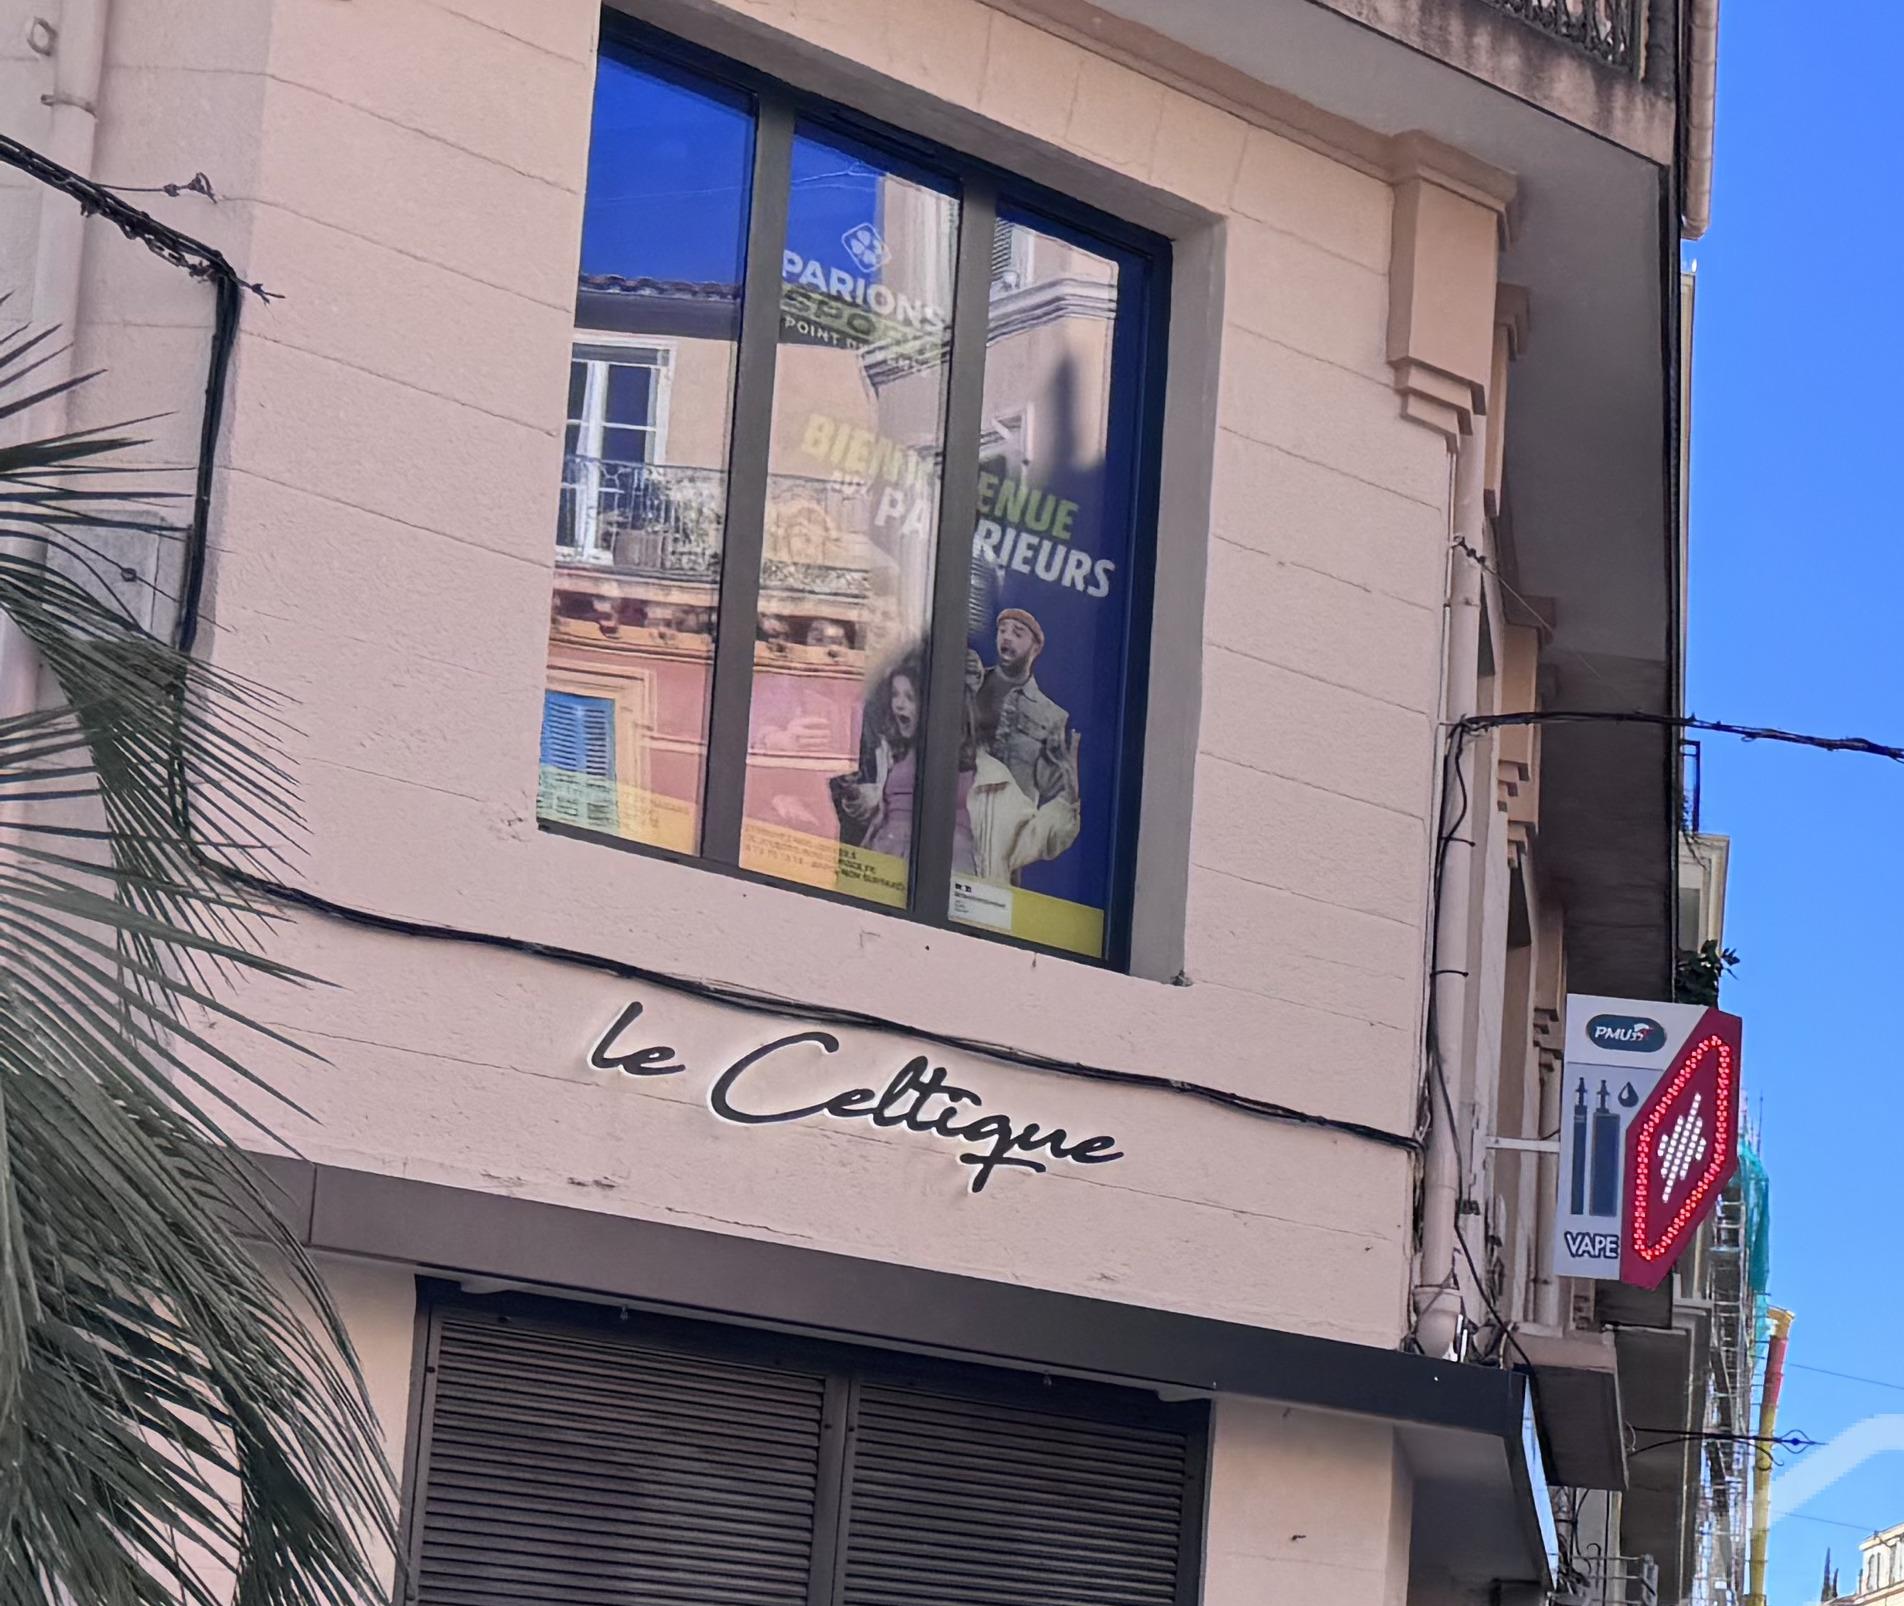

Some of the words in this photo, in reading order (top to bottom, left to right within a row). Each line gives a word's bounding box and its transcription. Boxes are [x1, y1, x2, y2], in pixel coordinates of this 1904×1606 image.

[1594, 1025, 1633, 1041] PMU
[709, 1030, 1124, 1193] Celtique
[1564, 1230, 1620, 1259] VAPE
